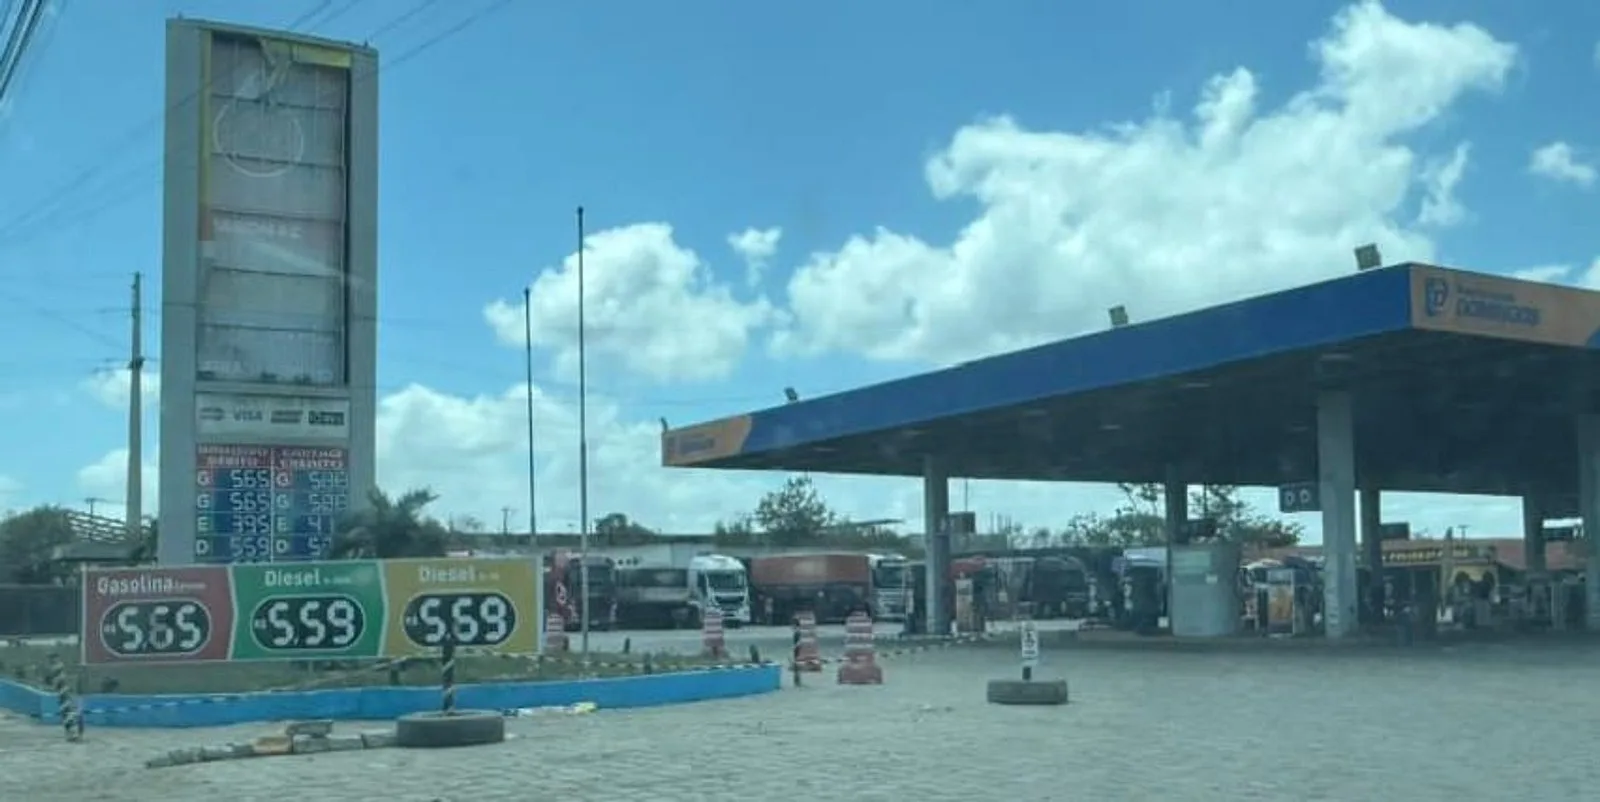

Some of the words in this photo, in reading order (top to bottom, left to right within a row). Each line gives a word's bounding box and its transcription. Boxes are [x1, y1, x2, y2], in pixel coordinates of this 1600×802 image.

[197, 470, 210, 486] G
[197, 494, 210, 509] G
[276, 494, 289, 509] G
[197, 517, 209, 531] E
[277, 517, 288, 532] E
[196, 539, 209, 555] D
[265, 567, 320, 587] Diesel
[418, 564, 475, 582] Diesel
[98, 573, 174, 595] Gasolina
